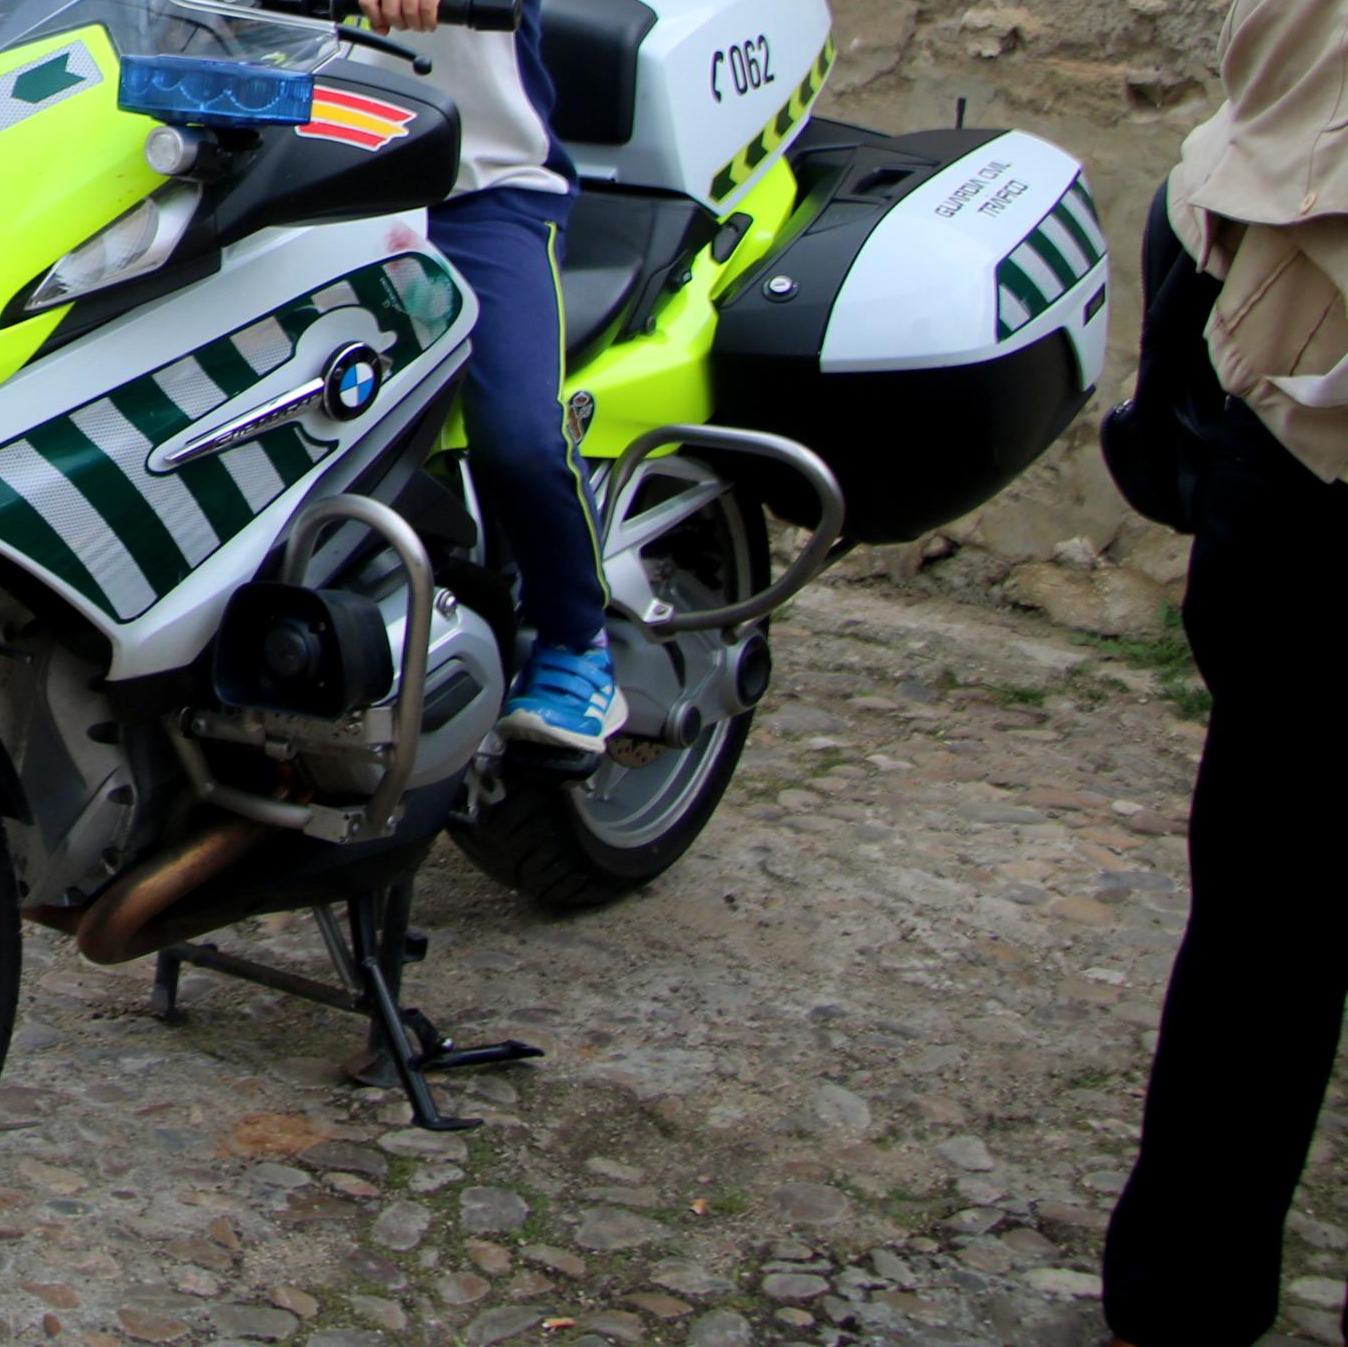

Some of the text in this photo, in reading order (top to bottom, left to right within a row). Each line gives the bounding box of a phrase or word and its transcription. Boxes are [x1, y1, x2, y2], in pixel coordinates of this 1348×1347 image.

[728, 34, 776, 96] 062
[934, 161, 1012, 219] GUARDIA CIVIL
